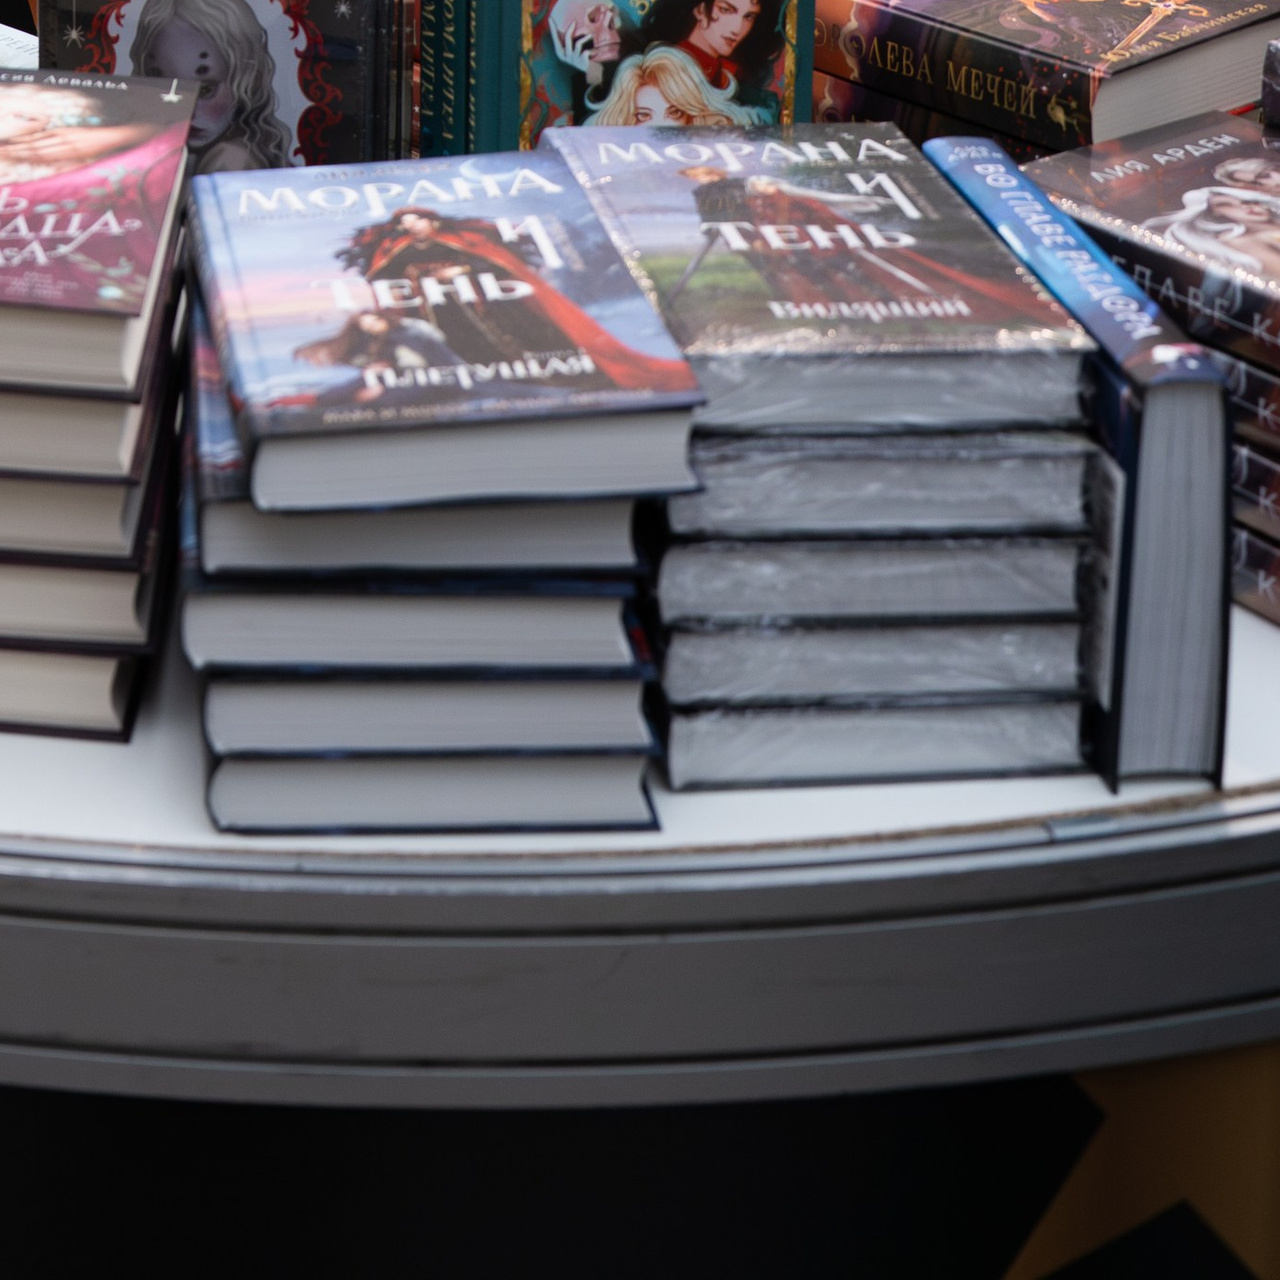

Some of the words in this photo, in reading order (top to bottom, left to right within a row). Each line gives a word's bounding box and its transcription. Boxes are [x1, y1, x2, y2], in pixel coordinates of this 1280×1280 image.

[946, 60, 1037, 120] МЕЧЕЙ
[598, 139, 907, 168] МОРАНА
[1090, 159, 1150, 184] ЛИЯ
[1152, 133, 1241, 165] АРДЕН
[238, 169, 563, 217] МОРАНА
